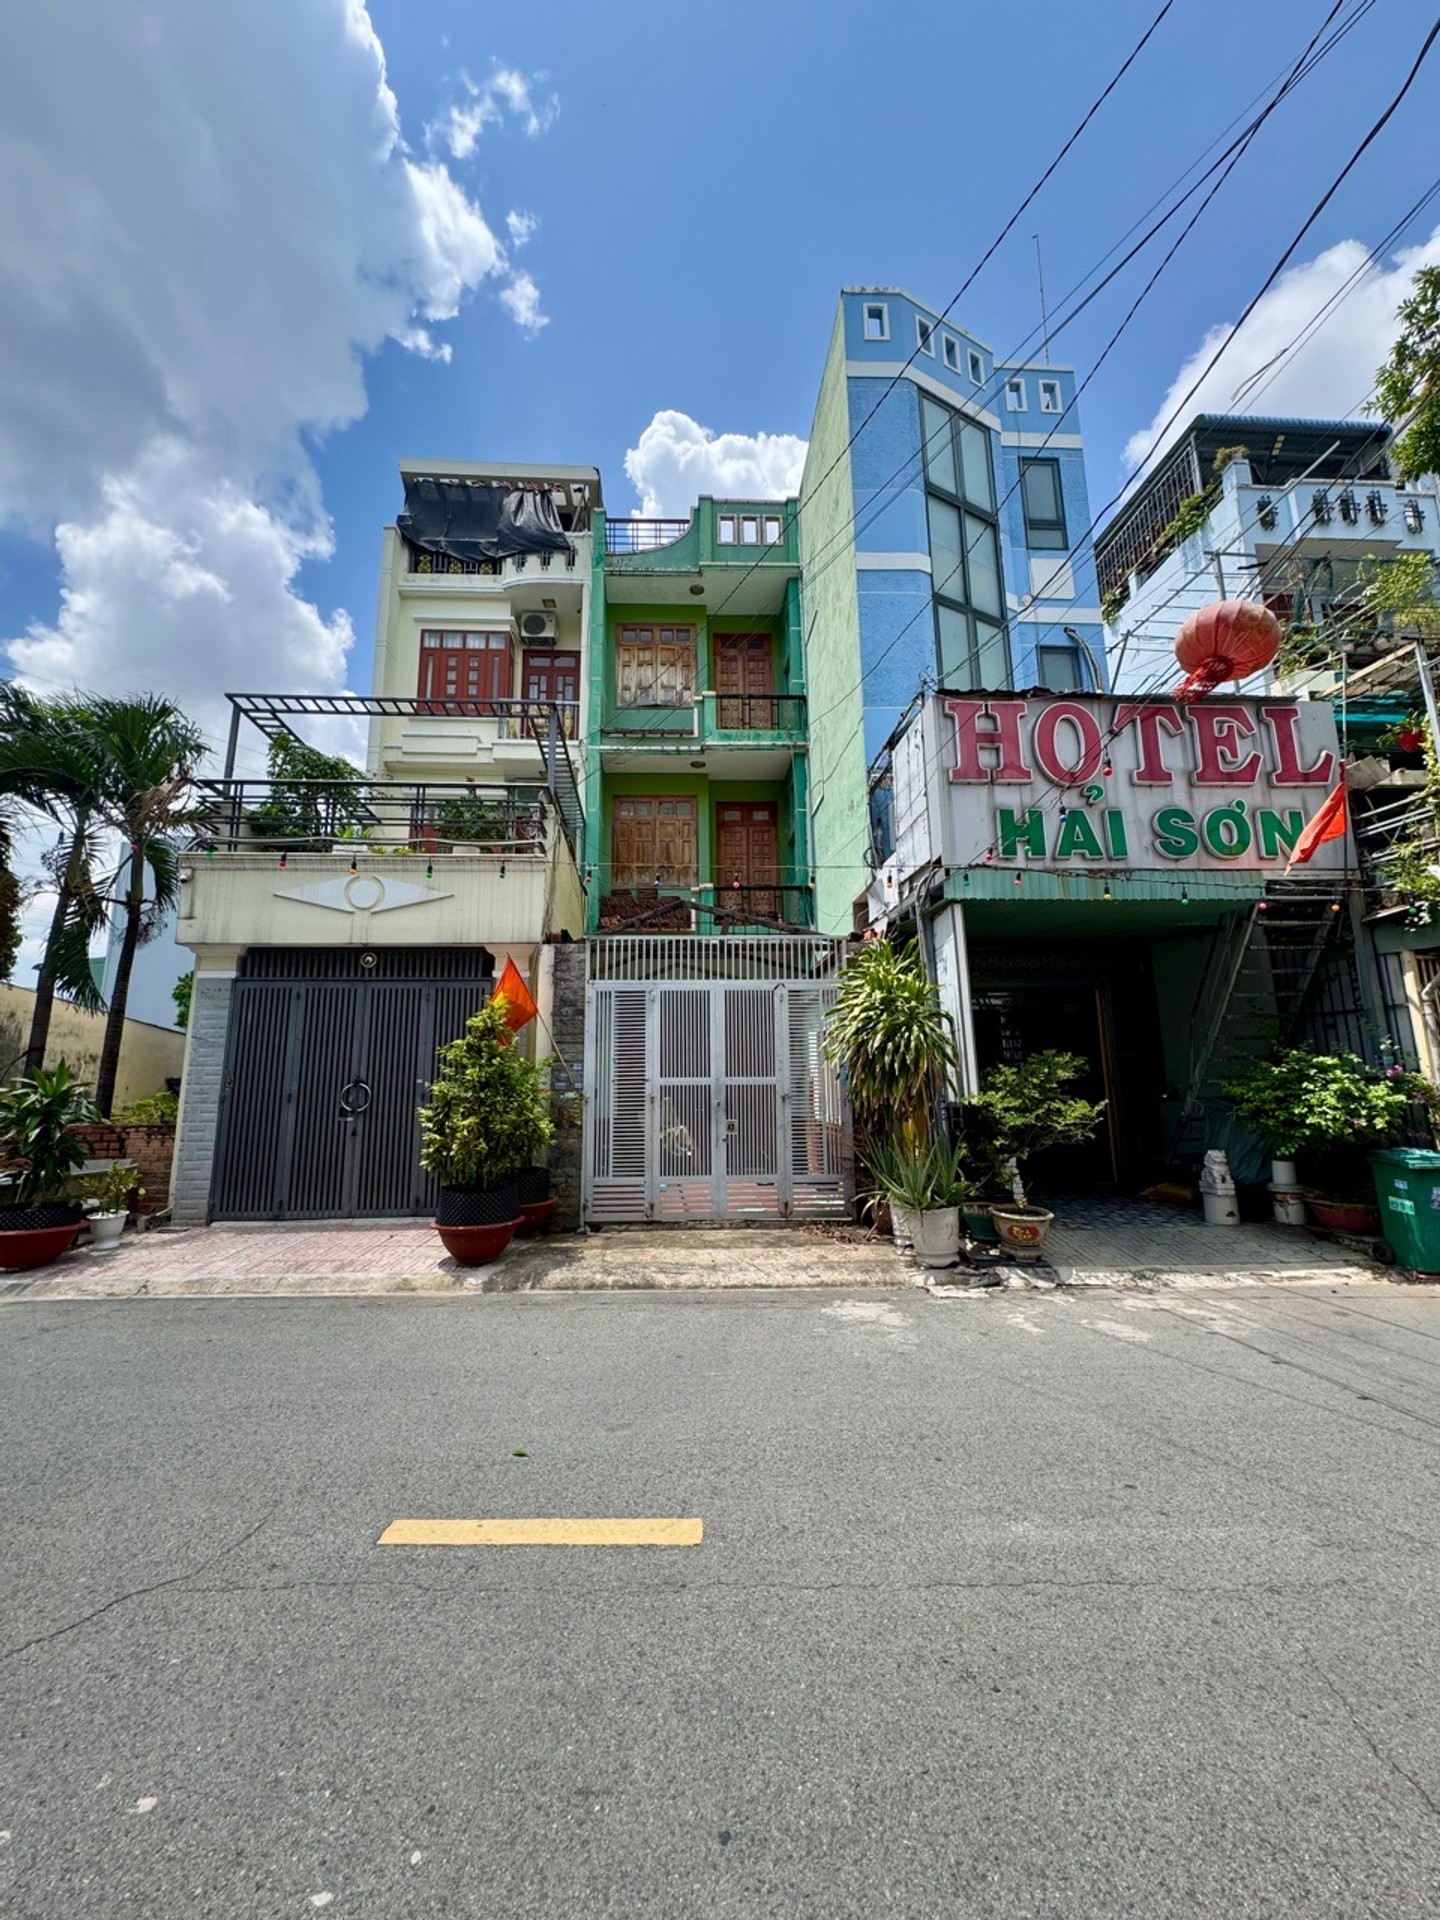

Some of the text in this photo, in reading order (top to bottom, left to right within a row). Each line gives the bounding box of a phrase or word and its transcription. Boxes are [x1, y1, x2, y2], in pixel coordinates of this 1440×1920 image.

[946, 702, 1335, 786] HOTEL
[997, 784, 1305, 861] HẢI SƠN
